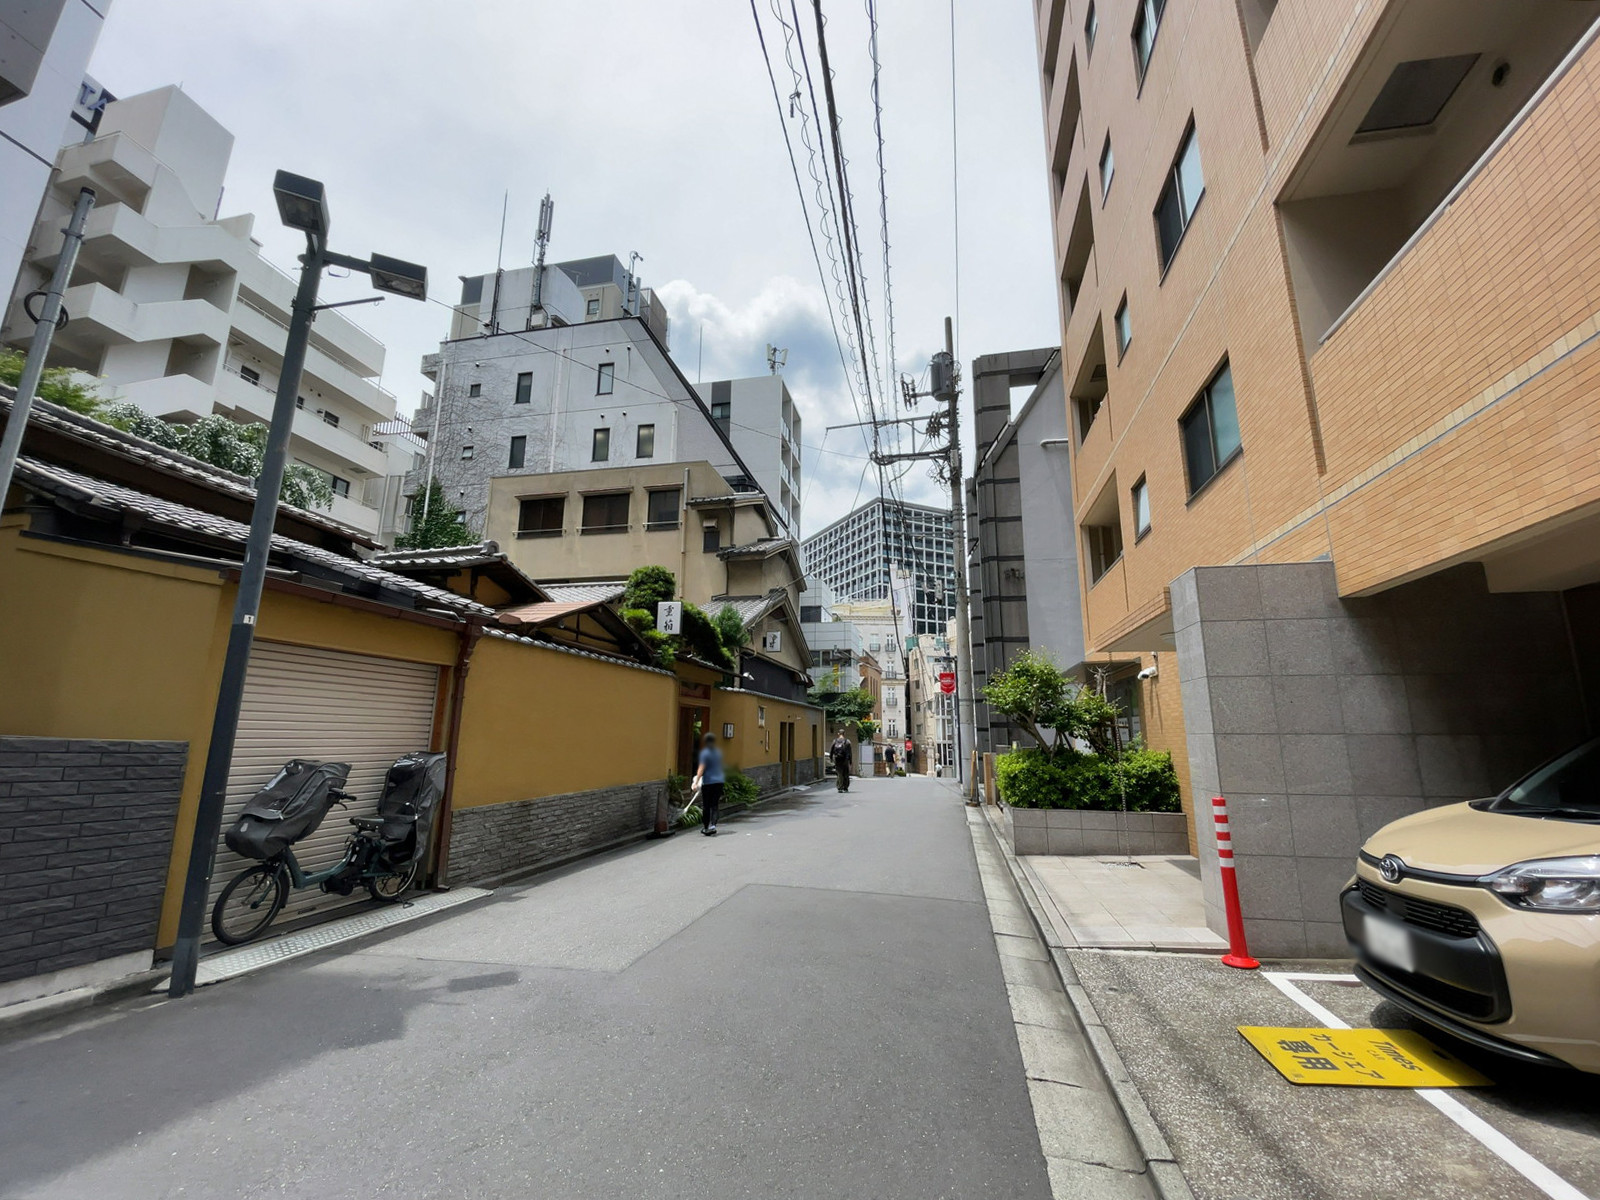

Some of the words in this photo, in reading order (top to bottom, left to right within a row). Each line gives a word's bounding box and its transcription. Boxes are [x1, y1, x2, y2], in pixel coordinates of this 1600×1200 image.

[1276, 1037, 1341, 1071] 専用
[1310, 1032, 1386, 1080] カーシェア
[1367, 1041, 1423, 1071] Times
